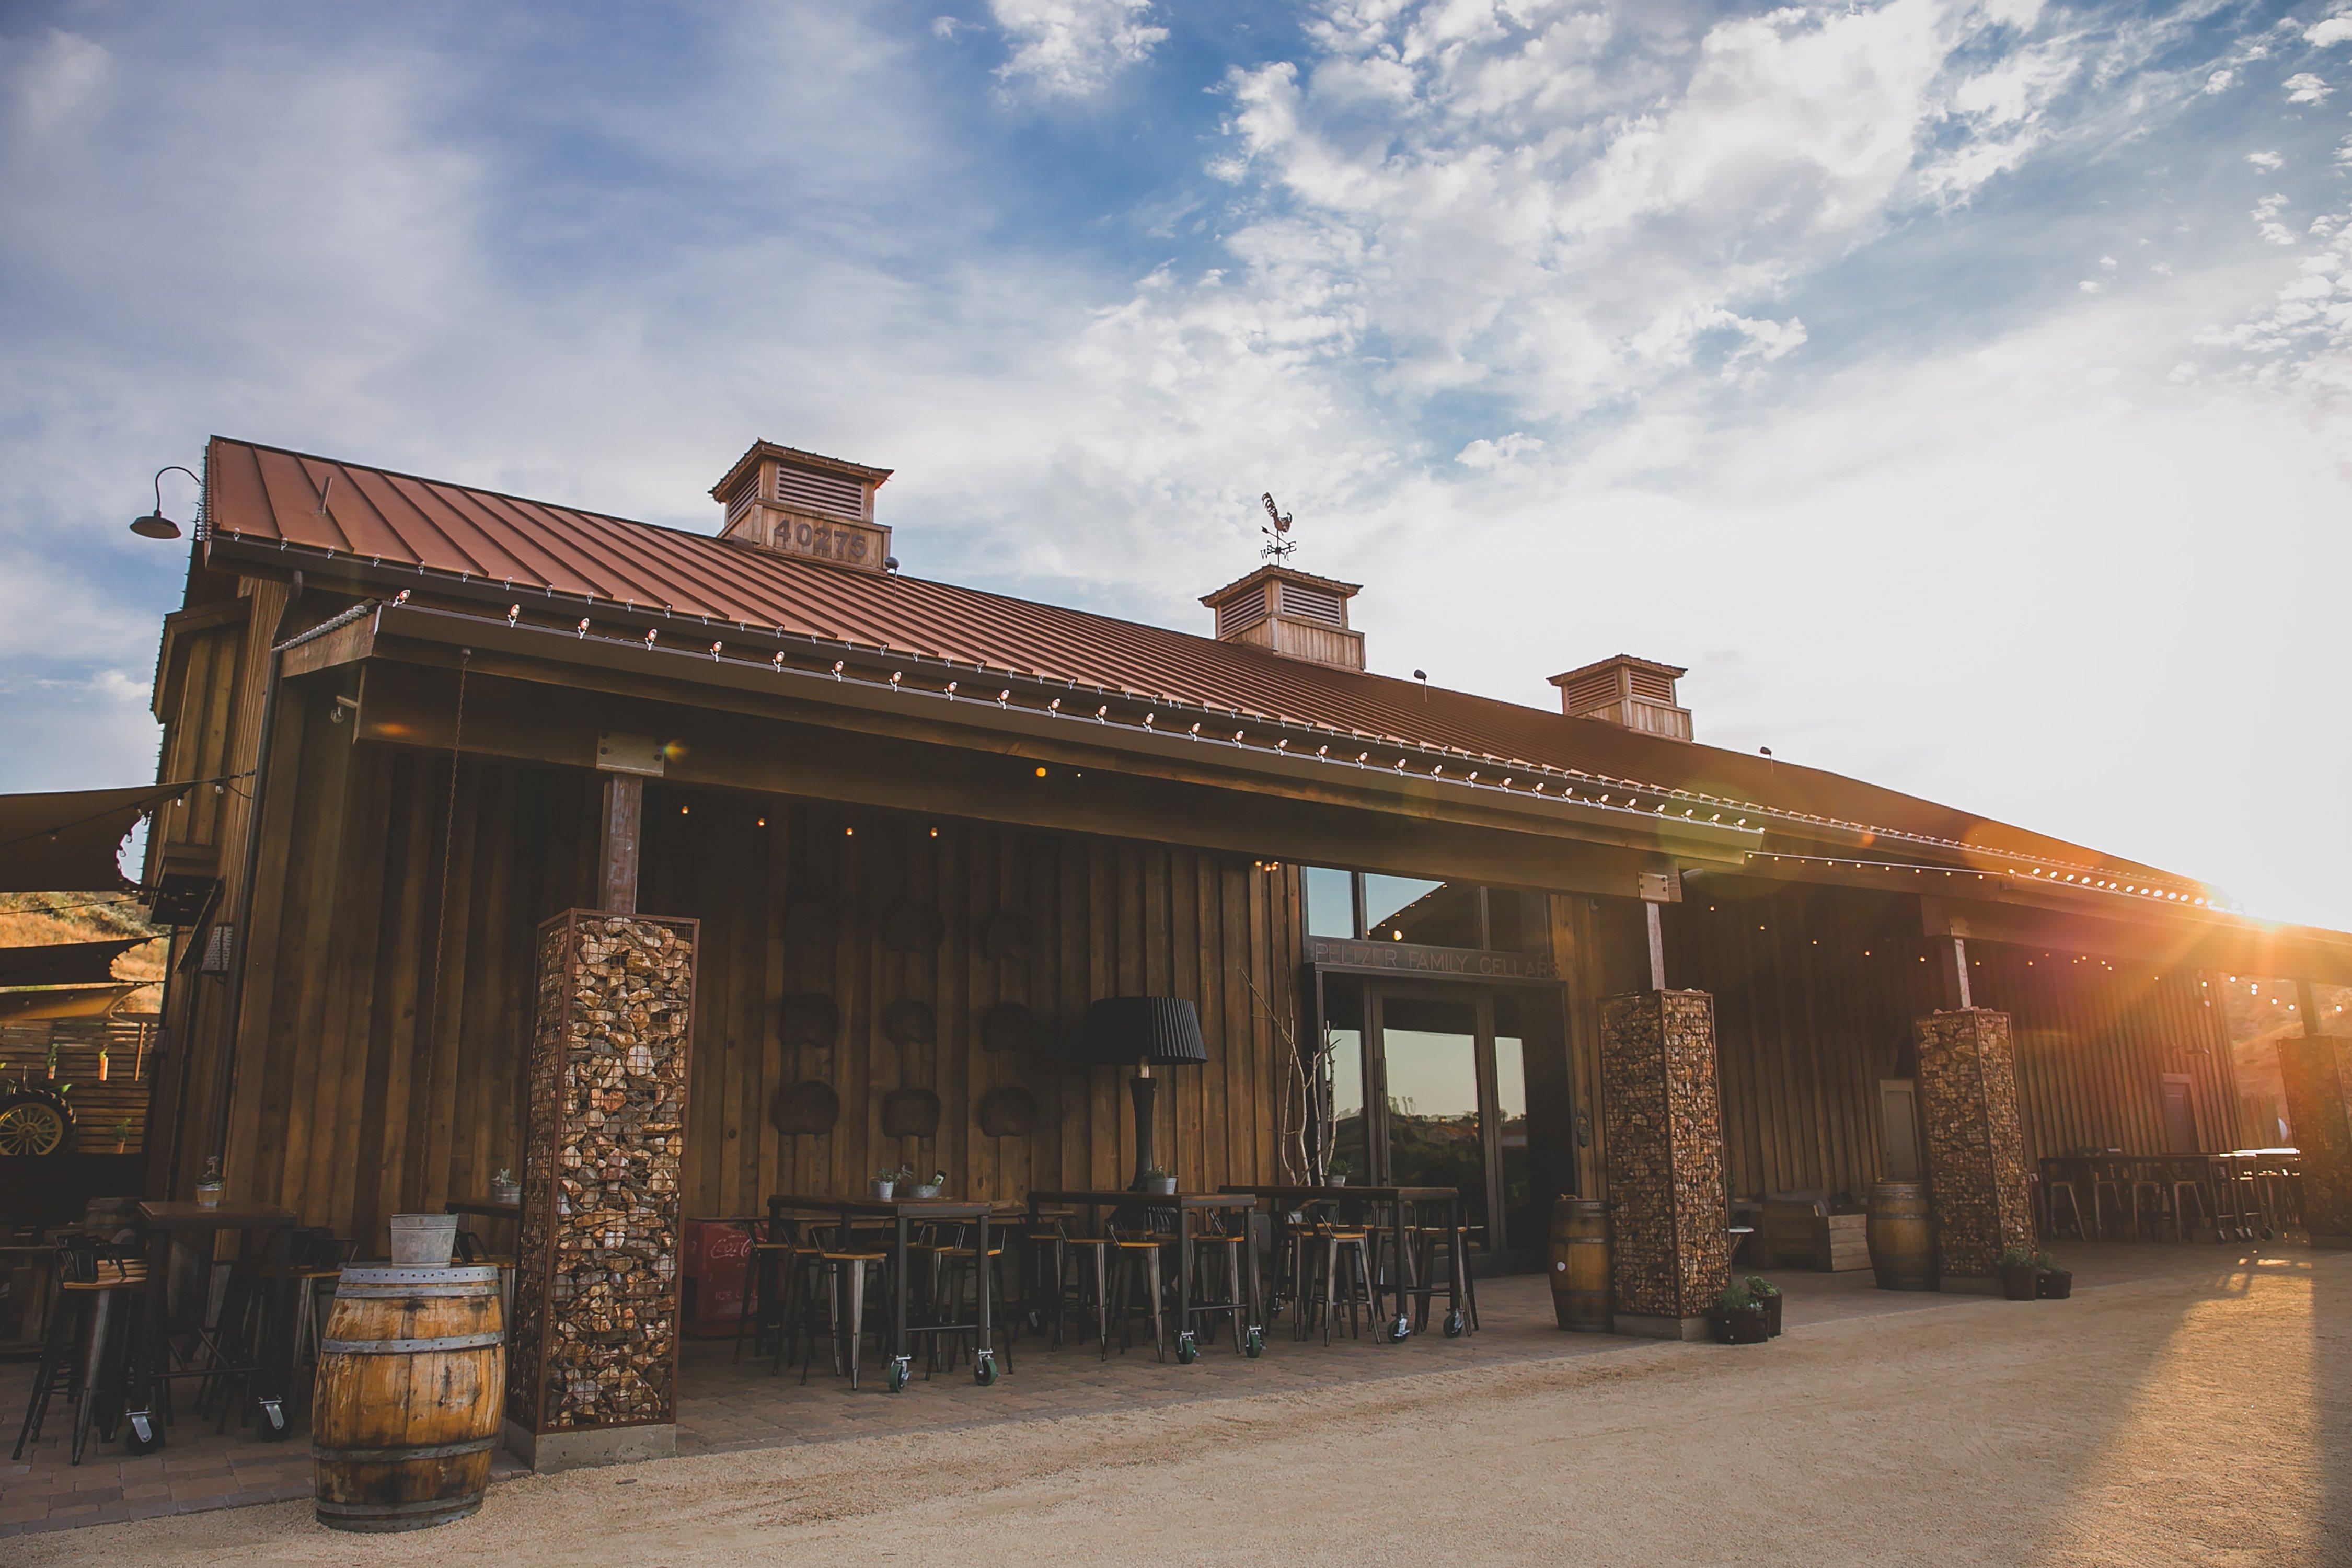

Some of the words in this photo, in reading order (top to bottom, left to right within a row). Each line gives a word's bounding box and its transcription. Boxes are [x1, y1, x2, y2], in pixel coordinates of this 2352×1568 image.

[774, 519, 866, 558] 40275
[1315, 943, 1397, 967] PELTZER
[1408, 950, 1468, 973] FAMILY
[1479, 956, 1561, 979] CELLARS
